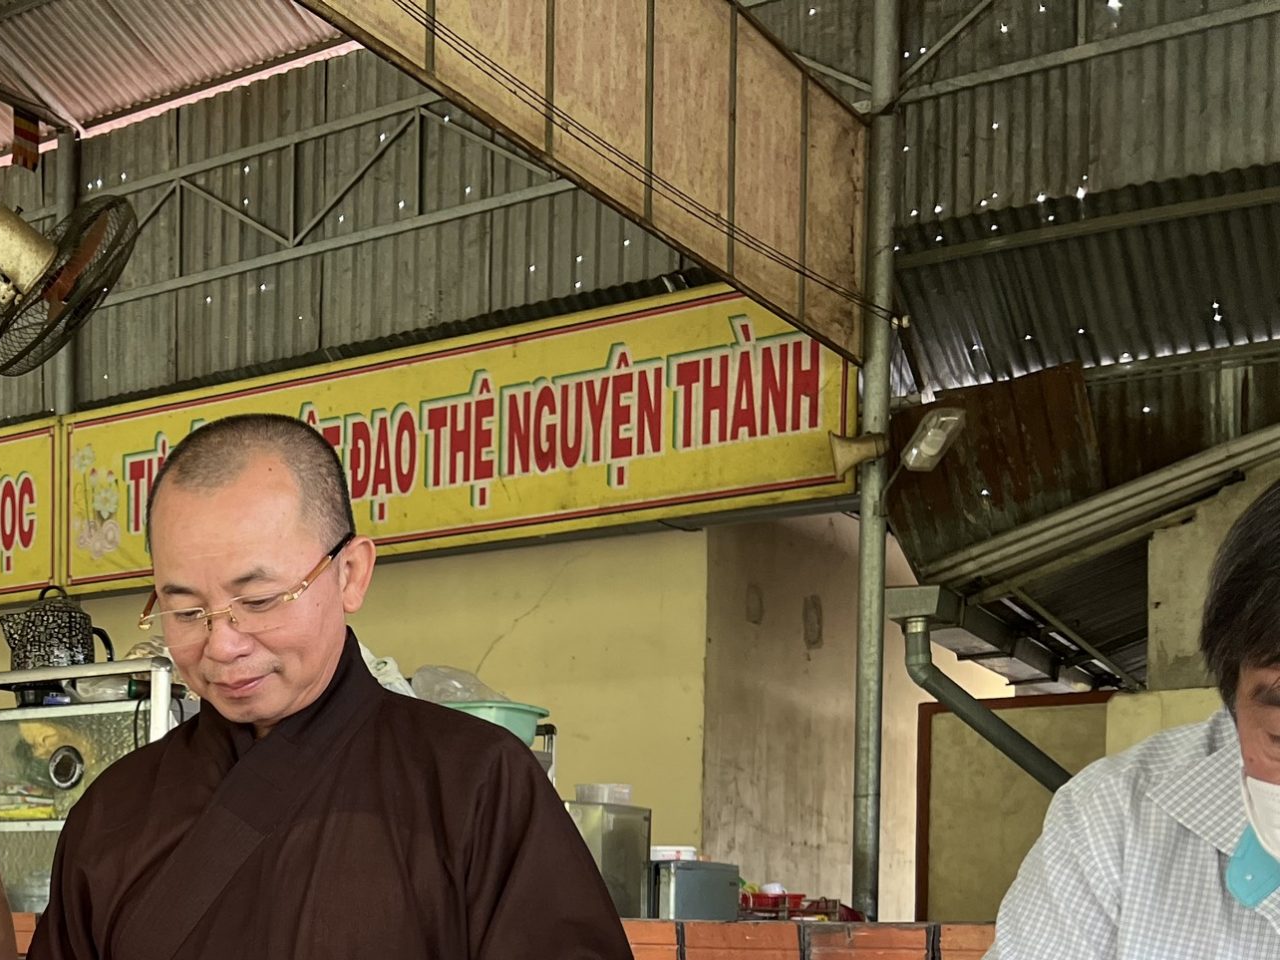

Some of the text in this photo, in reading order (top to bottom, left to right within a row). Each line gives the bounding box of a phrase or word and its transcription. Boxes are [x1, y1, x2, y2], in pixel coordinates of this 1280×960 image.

[350, 323, 820, 521] ĐẠO THỆ NGUYỆN THÀNH
